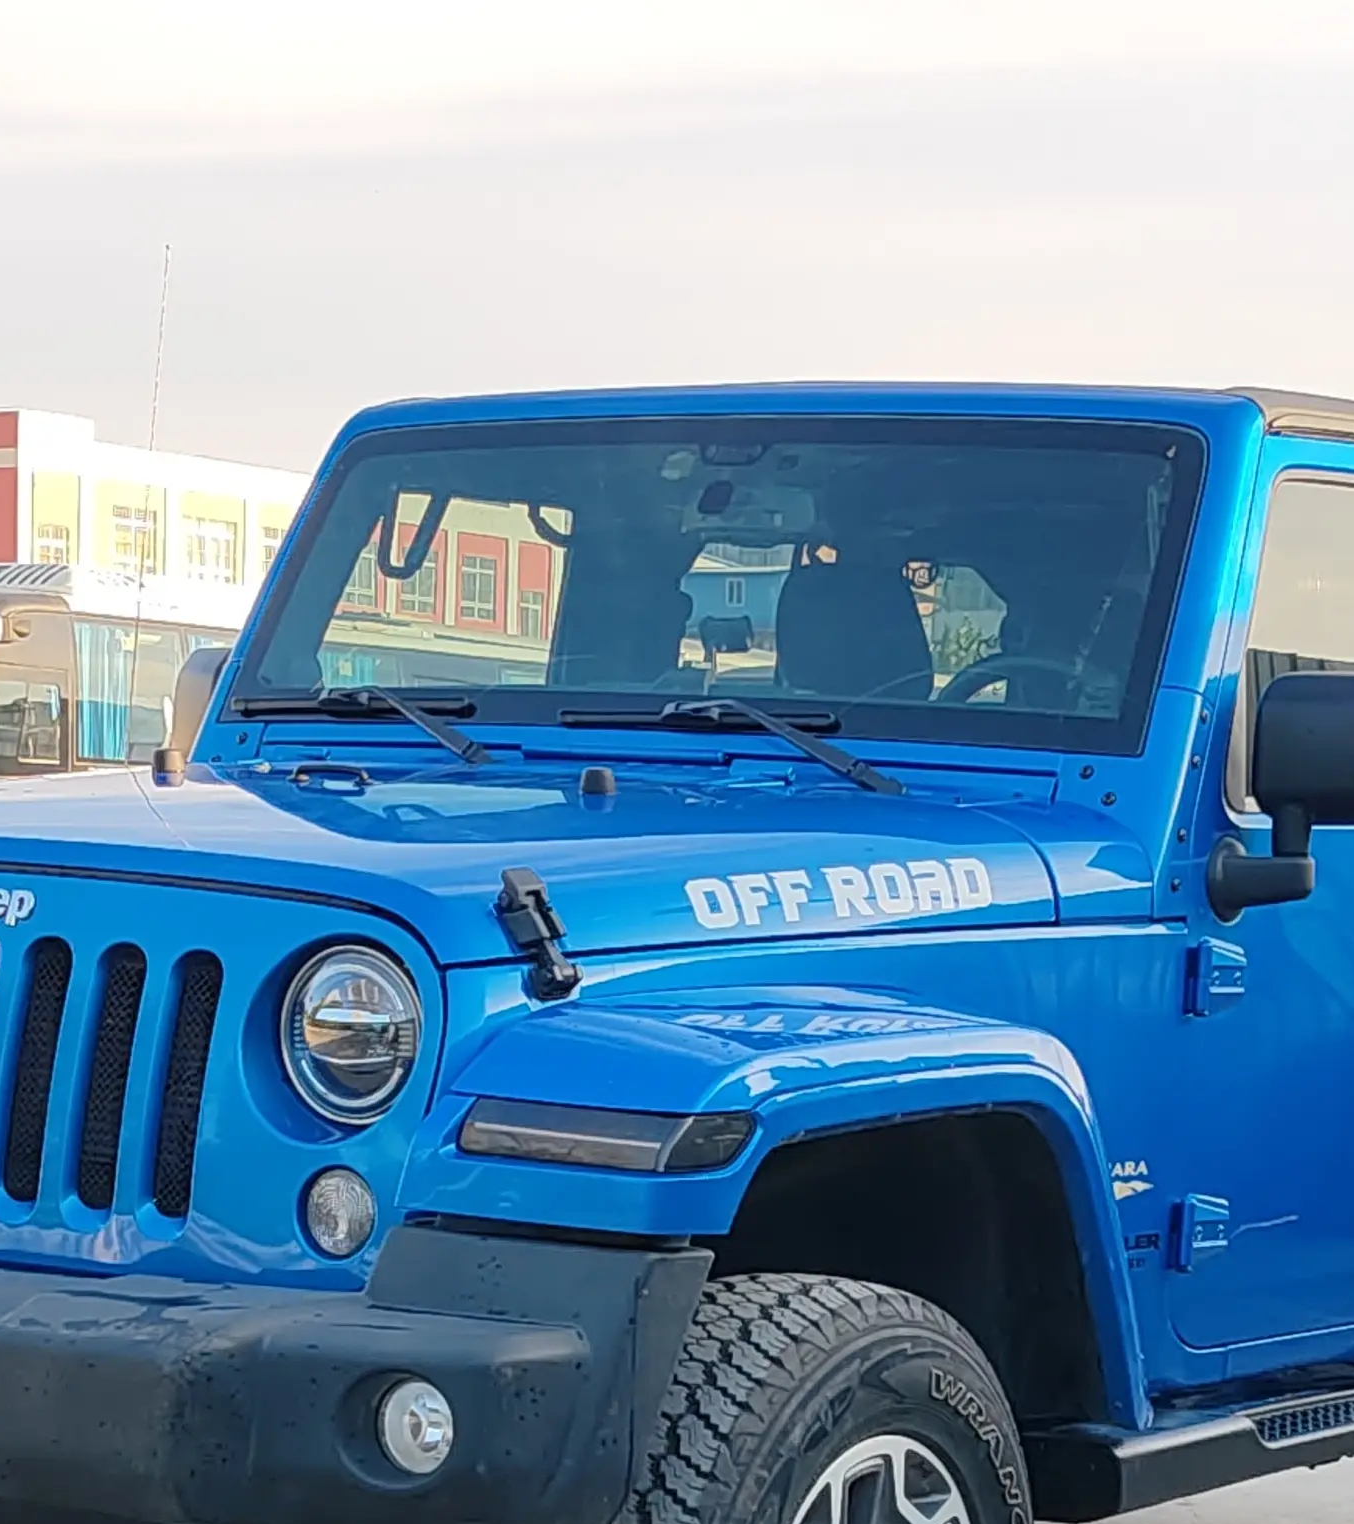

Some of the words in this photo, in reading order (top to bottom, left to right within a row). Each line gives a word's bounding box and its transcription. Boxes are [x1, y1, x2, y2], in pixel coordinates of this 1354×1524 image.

[684, 869, 813, 930] OFF
[819, 857, 993, 918] ROAD
[1108, 1159, 1149, 1177] ARA
